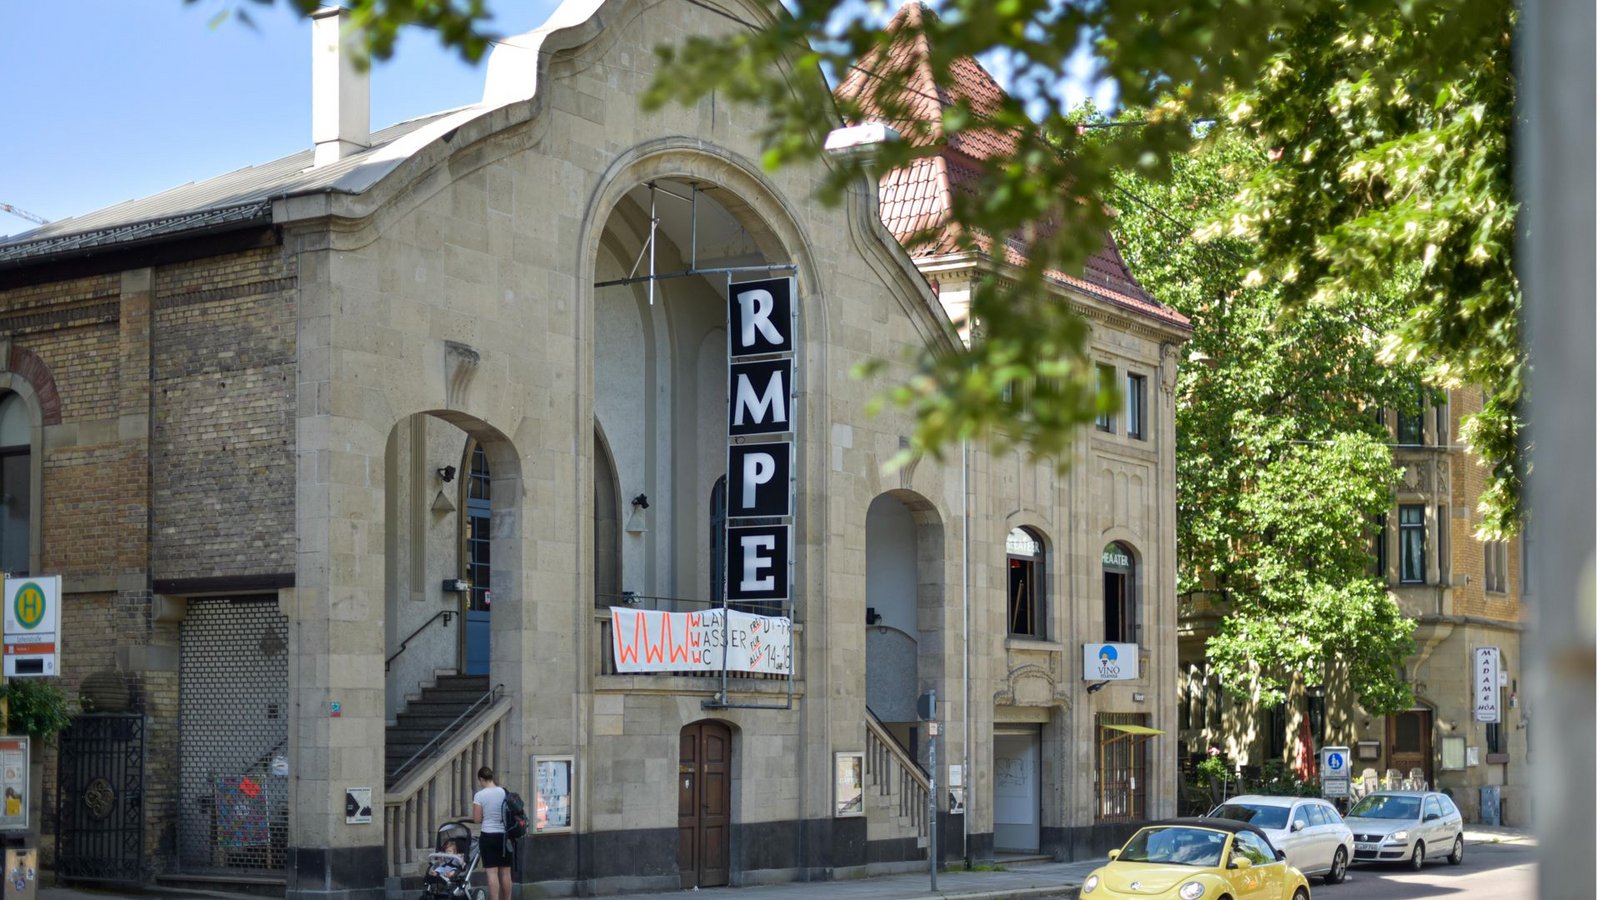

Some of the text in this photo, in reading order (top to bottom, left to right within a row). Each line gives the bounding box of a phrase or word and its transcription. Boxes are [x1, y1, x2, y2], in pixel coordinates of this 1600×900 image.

[732, 289, 788, 591] RMPE
[23, 593, 37, 617] H
[690, 611, 726, 628] WLAN
[690, 629, 747, 649] WASSER
[691, 648, 712, 666] WC
[1098, 666, 1121, 674] VINO
